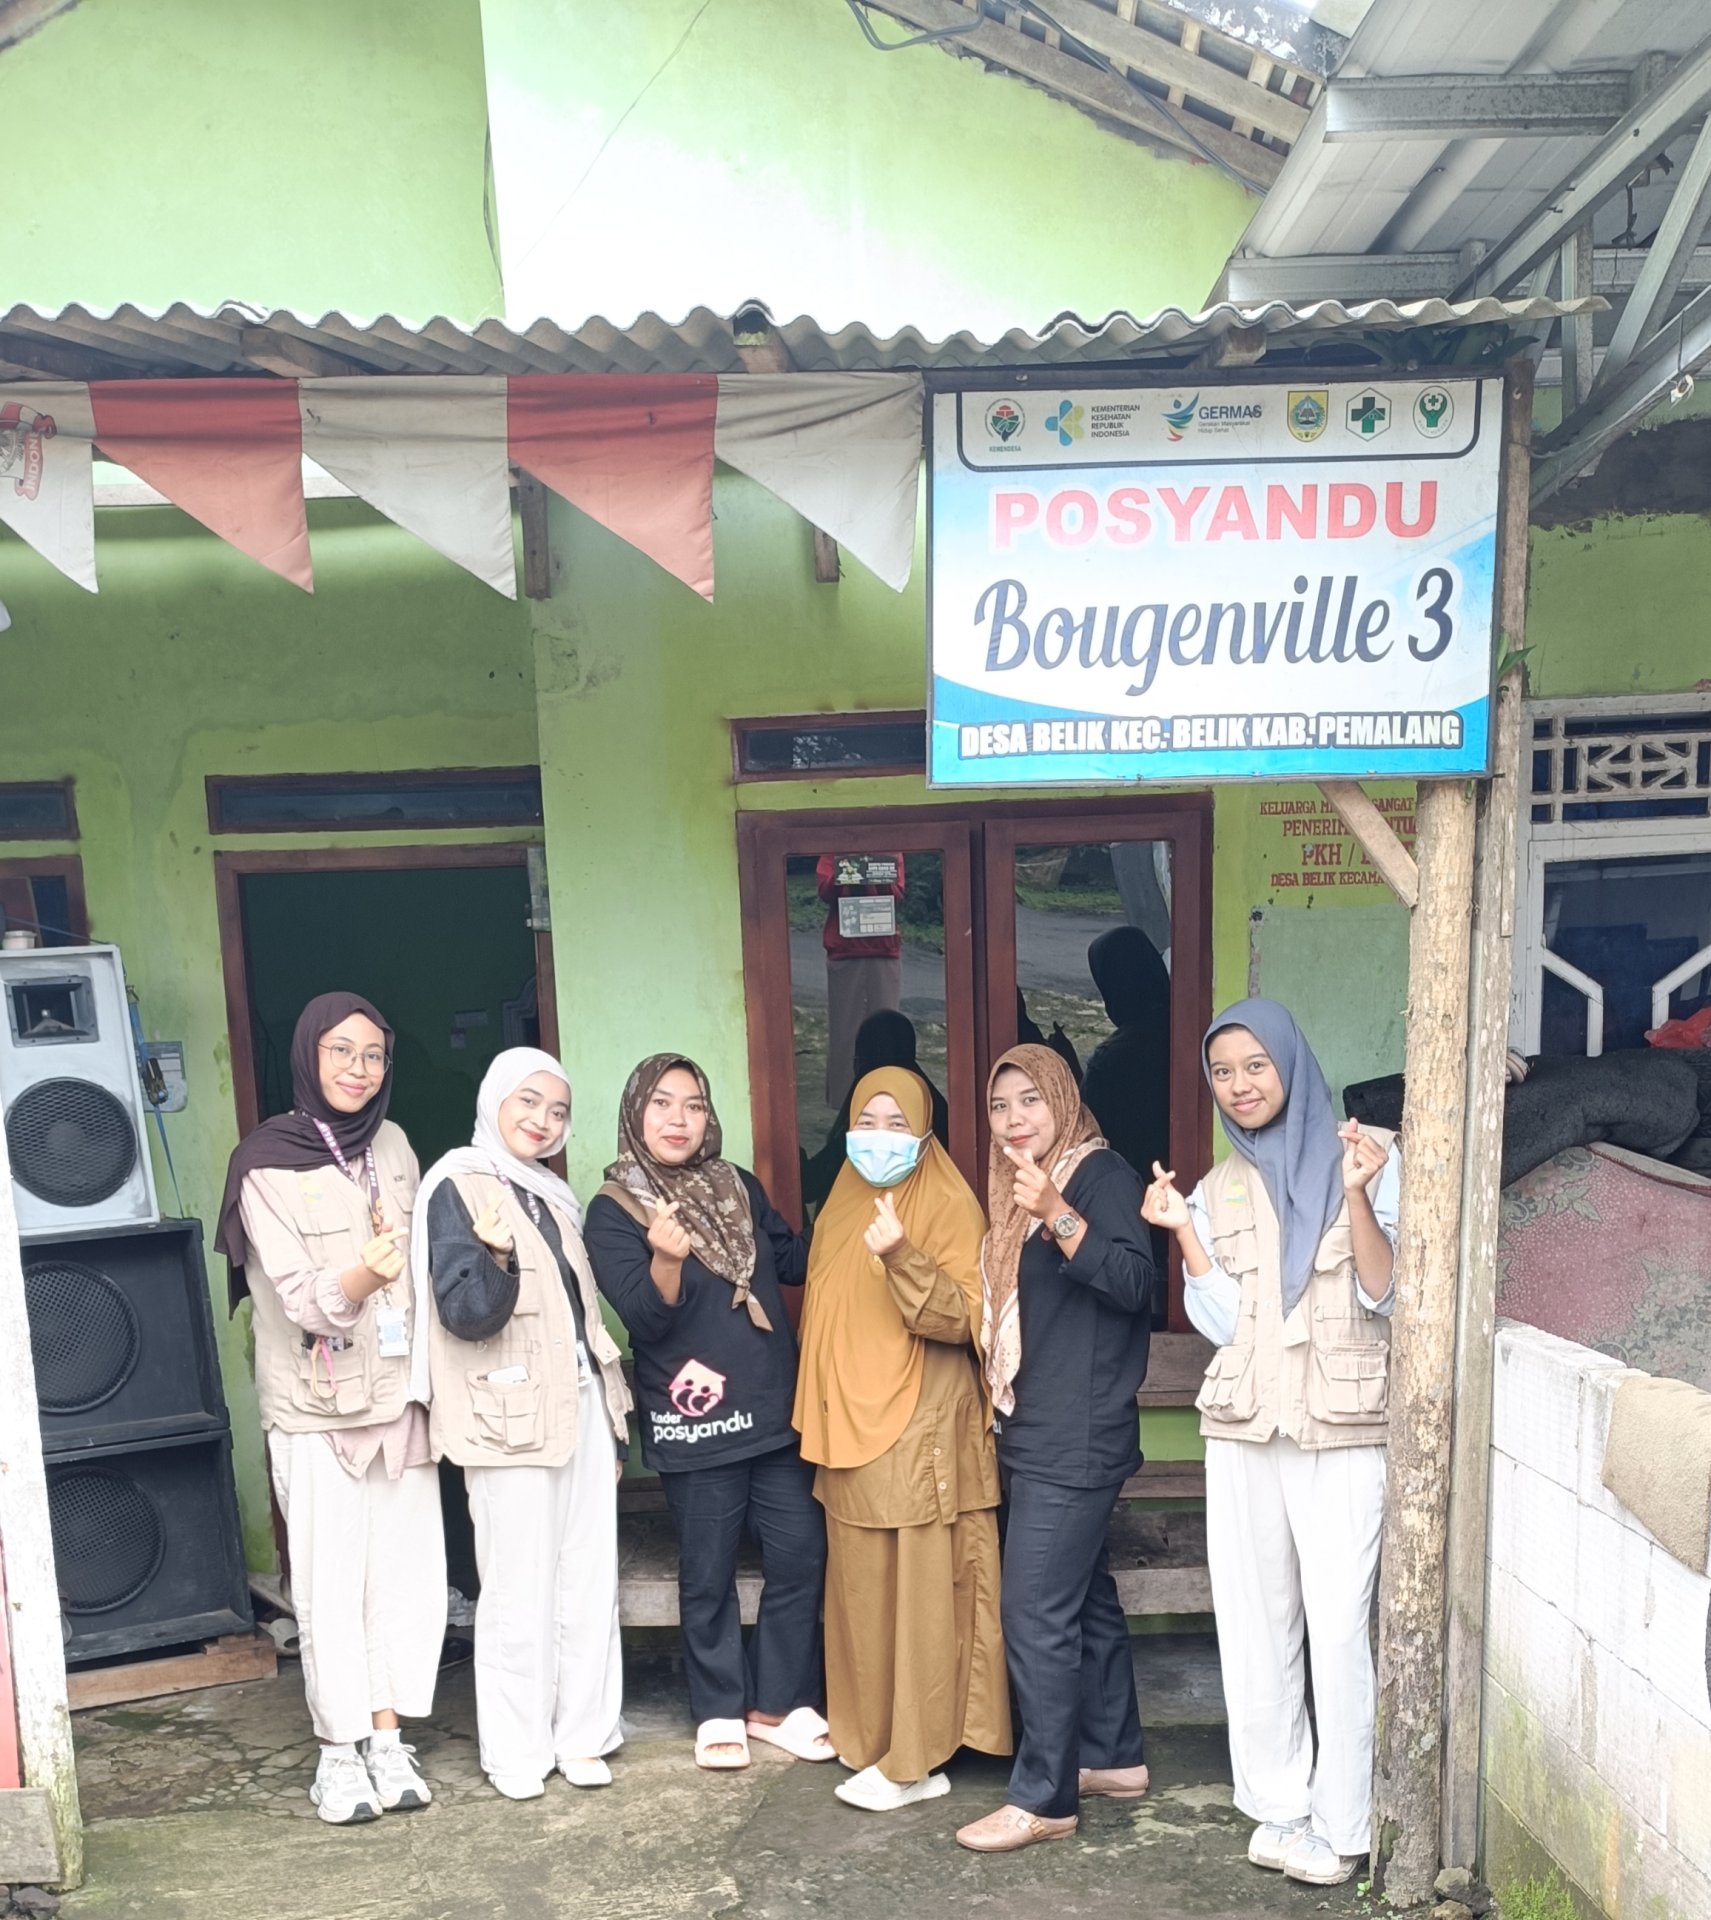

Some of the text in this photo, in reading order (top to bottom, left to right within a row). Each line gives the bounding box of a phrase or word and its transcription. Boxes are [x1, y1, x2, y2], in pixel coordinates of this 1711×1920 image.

[1091, 404, 1141, 413] KEMENTERIAN
[1199, 404, 1262, 419] GERMAS
[1091, 413, 1132, 421] KESEHATAN
[1091, 430, 1130, 438] INDONESIA
[995, 481, 1438, 547] POSYANDU
[974, 567, 1454, 697] Bougenville 3
[961, 723, 1028, 757] DESA
[1032, 720, 1106, 752] BELIK
[1173, 717, 1248, 749] BELIK
[1318, 714, 1460, 746] PEMALANG
[1260, 800, 1316, 815] KELUARGA
[1371, 798, 1415, 812] SANGAT
[1283, 818, 1352, 836] PENERIM
[1302, 843, 1342, 866] PKH
[1271, 871, 1384, 887] DESA BELIK KECAMA
[650, 1410, 683, 1424] Kader
[653, 1410, 754, 1444] posyandu
